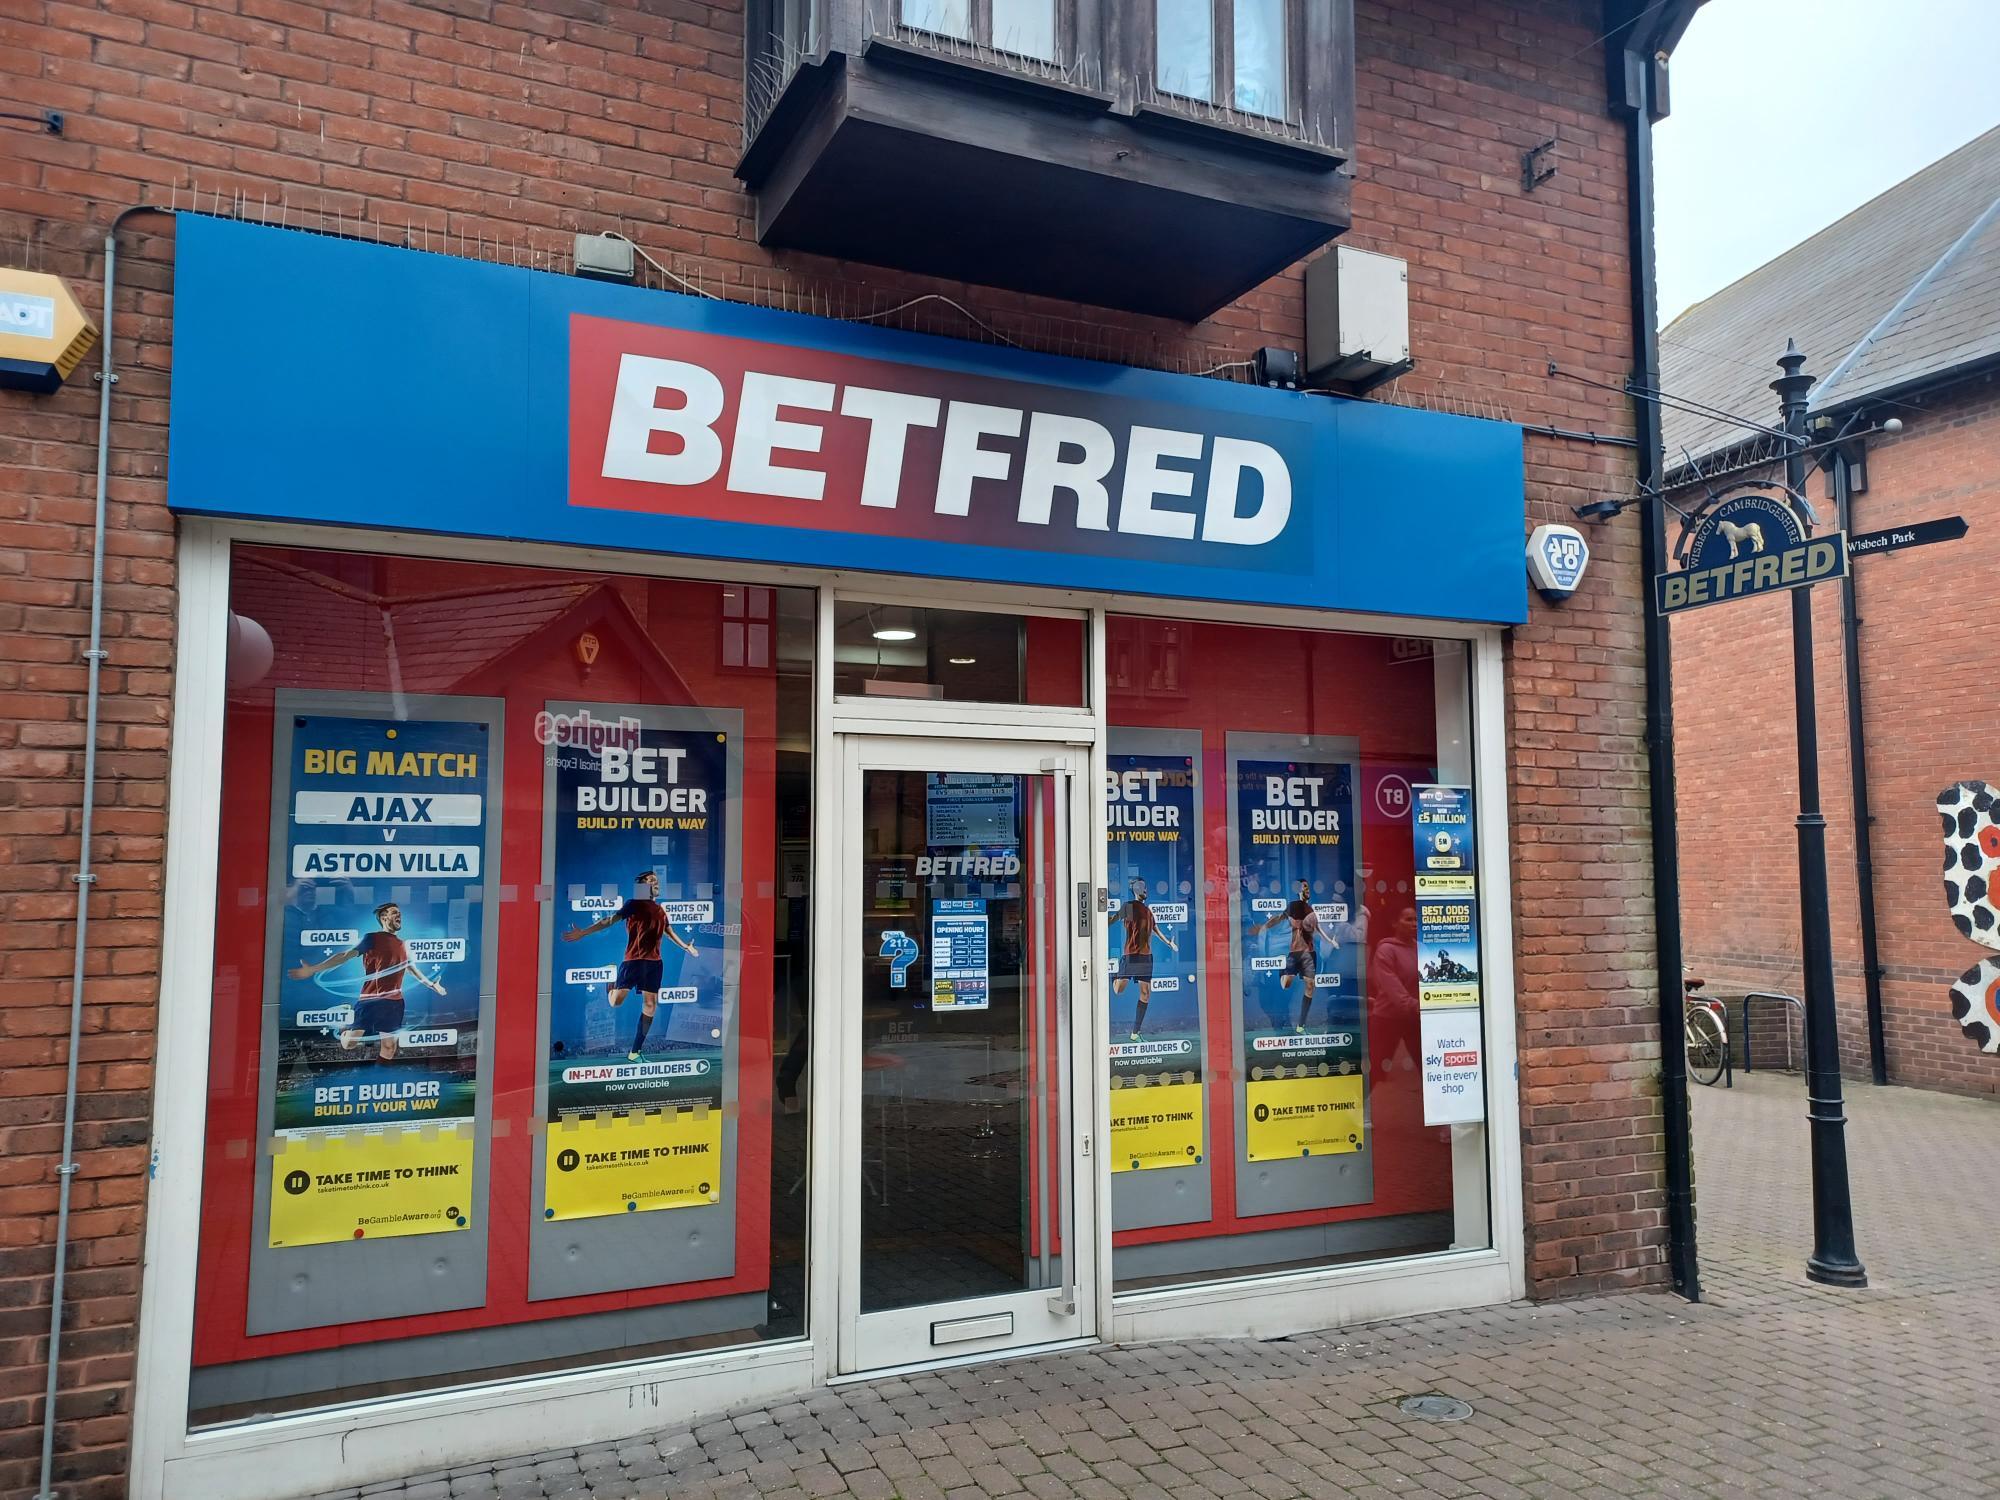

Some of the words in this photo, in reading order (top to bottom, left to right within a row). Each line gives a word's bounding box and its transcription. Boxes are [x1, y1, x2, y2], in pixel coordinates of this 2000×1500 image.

[600, 353, 1293, 547] BETFRED
[1719, 499, 1799, 545] CAMBRIDGESHIRE
[1690, 519, 1715, 568] WISBECH
[1847, 536, 1888, 552] Wisbech
[1892, 531, 1916, 545] Park
[1664, 542, 1836, 608] BETFRED
[304, 749, 356, 774] BIG
[366, 751, 477, 778] MATCH
[601, 747, 686, 783] BET
[1266, 776, 1324, 807] BET
[577, 786, 707, 813] BUILDER
[347, 796, 433, 822] AJAX
[577, 817, 618, 829] BUILD
[621, 817, 635, 829] IT
[638, 817, 674, 829] YOUR
[678, 818, 707, 829] WAY
[1252, 809, 1340, 831] BUILDER
[1418, 812, 1431, 824] £5
[1432, 814, 1466, 824] MILLION
[1117, 831, 1126, 842] IT
[1129, 832, 1155, 842] YOUR
[1158, 832, 1179, 842] WAY
[1253, 834, 1280, 845] BUILD
[1282, 834, 1291, 845] IT
[1293, 834, 1317, 845] YOUR
[1319, 835, 1340, 845] WAY
[304, 853, 391, 872] ASTON
[399, 853, 469, 872] VILLA
[916, 857, 1020, 876] BETFRED
[580, 898, 615, 908] GOALS
[665, 904, 695, 913] SHOTS
[697, 904, 710, 912] ON
[1258, 901, 1282, 909] GOALS
[1422, 906, 1444, 915] BEST
[1446, 906, 1470, 915] ODDS
[670, 914, 704, 922] TARGET
[1422, 916, 1470, 924] GUARANTEED
[1443, 924, 1470, 932] meetings
[310, 932, 350, 942] GOALS
[410, 941, 443, 951] SHOTS
[446, 941, 461, 950] ON
[415, 951, 455, 960] TARGET
[1256, 960, 1283, 968] RESULT
[571, 970, 611, 981] RESULT
[1316, 976, 1339, 984] CARDS
[1153, 980, 1177, 989] CARDS
[661, 990, 695, 1000] CARDS
[303, 1013, 348, 1023] RESULT
[408, 1033, 448, 1044] CARDS
[1257, 1039, 1286, 1048] IN-PLAY
[1289, 1038, 1303, 1046] BET
[1306, 1036, 1340, 1046] BUILDERS
[1437, 1038, 1466, 1049] Watch
[1122, 1046, 1137, 1054] BET
[1140, 1043, 1178, 1053] BUILDERS
[1297, 1049, 1327, 1057] available
[1131, 1057, 1163, 1065] available
[1426, 1054, 1442, 1067] sky
[1445, 1054, 1476, 1066] sports
[568, 1068, 613, 1081] IN-PLAY
[616, 1067, 637, 1078] BET
[640, 1063, 691, 1076] BUILDERS
[1427, 1072, 1442, 1082] live
[1444, 1071, 1451, 1081] in
[1453, 1071, 1478, 1082] every
[605, 1083, 625, 1091] now
[627, 1079, 669, 1090] available
[1442, 1084, 1464, 1095] shop
[315, 1086, 353, 1103] BET
[359, 1081, 440, 1100] BUILDER
[314, 1103, 352, 1116] BUILD
[355, 1102, 368, 1114] IT
[373, 1100, 407, 1113] YOUR
[411, 1098, 439, 1110] WAY
[1272, 1107, 1293, 1116] TAKE
[1295, 1105, 1315, 1114] TIME
[1317, 1104, 1328, 1112] TO
[1330, 1102, 1356, 1111] THINK
[1128, 1116, 1150, 1126] TIME
[1152, 1114, 1164, 1123] TO
[1166, 1112, 1193, 1121] THINK
[585, 1152, 617, 1163] TAKE
[620, 1149, 649, 1160] TIME
[653, 1147, 670, 1157] TO
[672, 1143, 710, 1155] THINK
[316, 1174, 353, 1186] TAKE
[356, 1170, 391, 1182] TIME
[394, 1168, 413, 1179] TO
[416, 1165, 459, 1177] THINK
[317, 1182, 389, 1194] taketimetothink.co.uk
